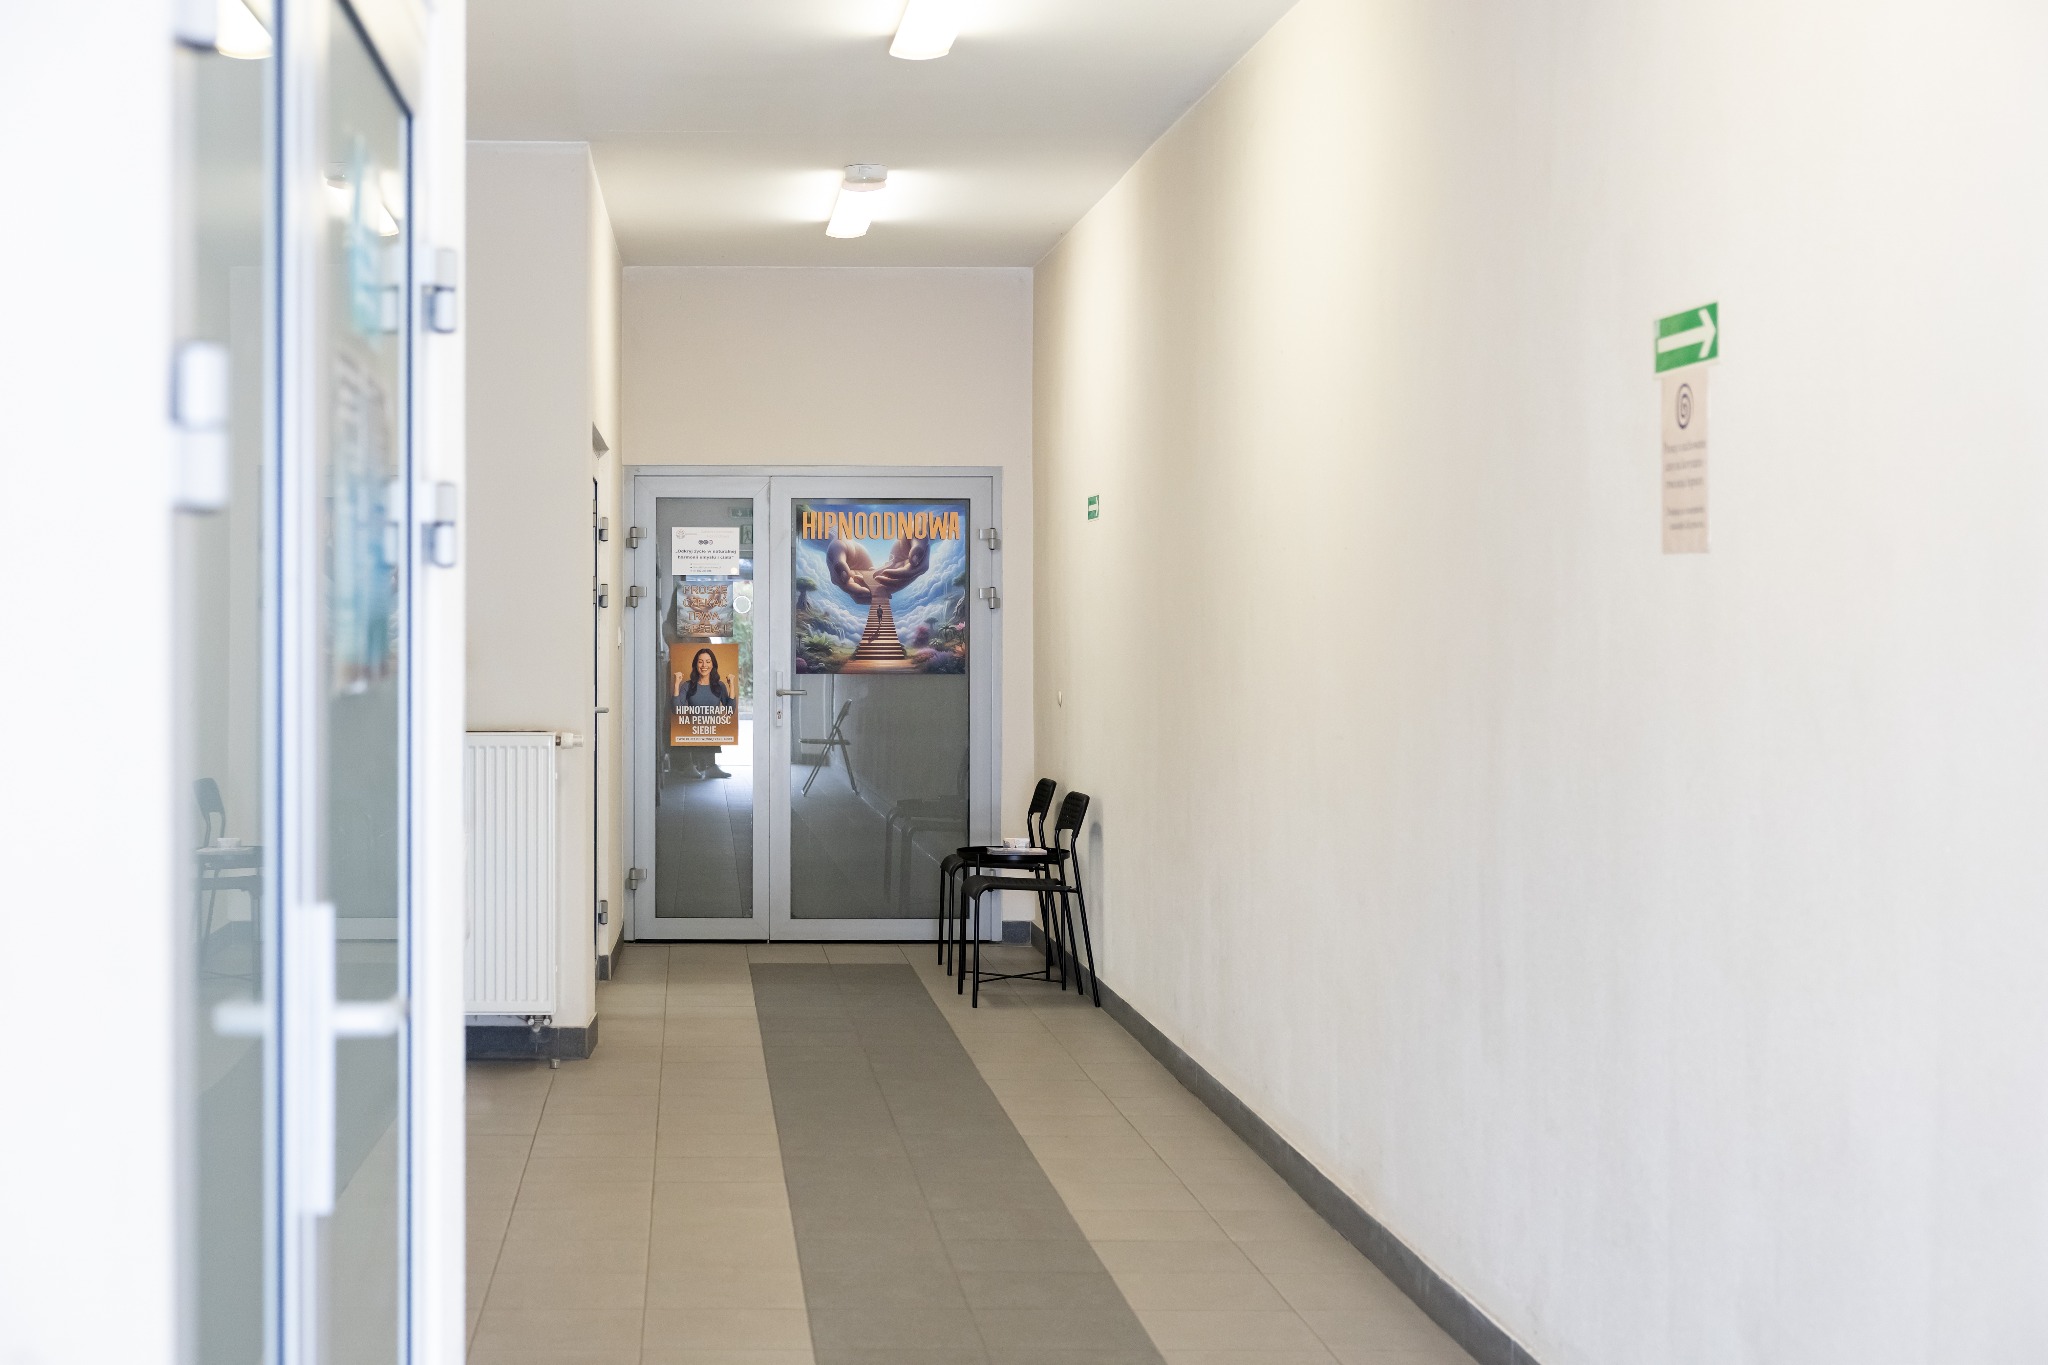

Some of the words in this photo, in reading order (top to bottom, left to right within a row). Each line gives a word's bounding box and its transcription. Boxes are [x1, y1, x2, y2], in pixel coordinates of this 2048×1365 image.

[802, 511, 960, 540] HIPNOODNOWA
[676, 706, 733, 715] HIPNOTERAPIA
[679, 716, 690, 724] NA
[692, 714, 731, 725] PEWNOŚĆ
[692, 726, 717, 735] SIEBIE
